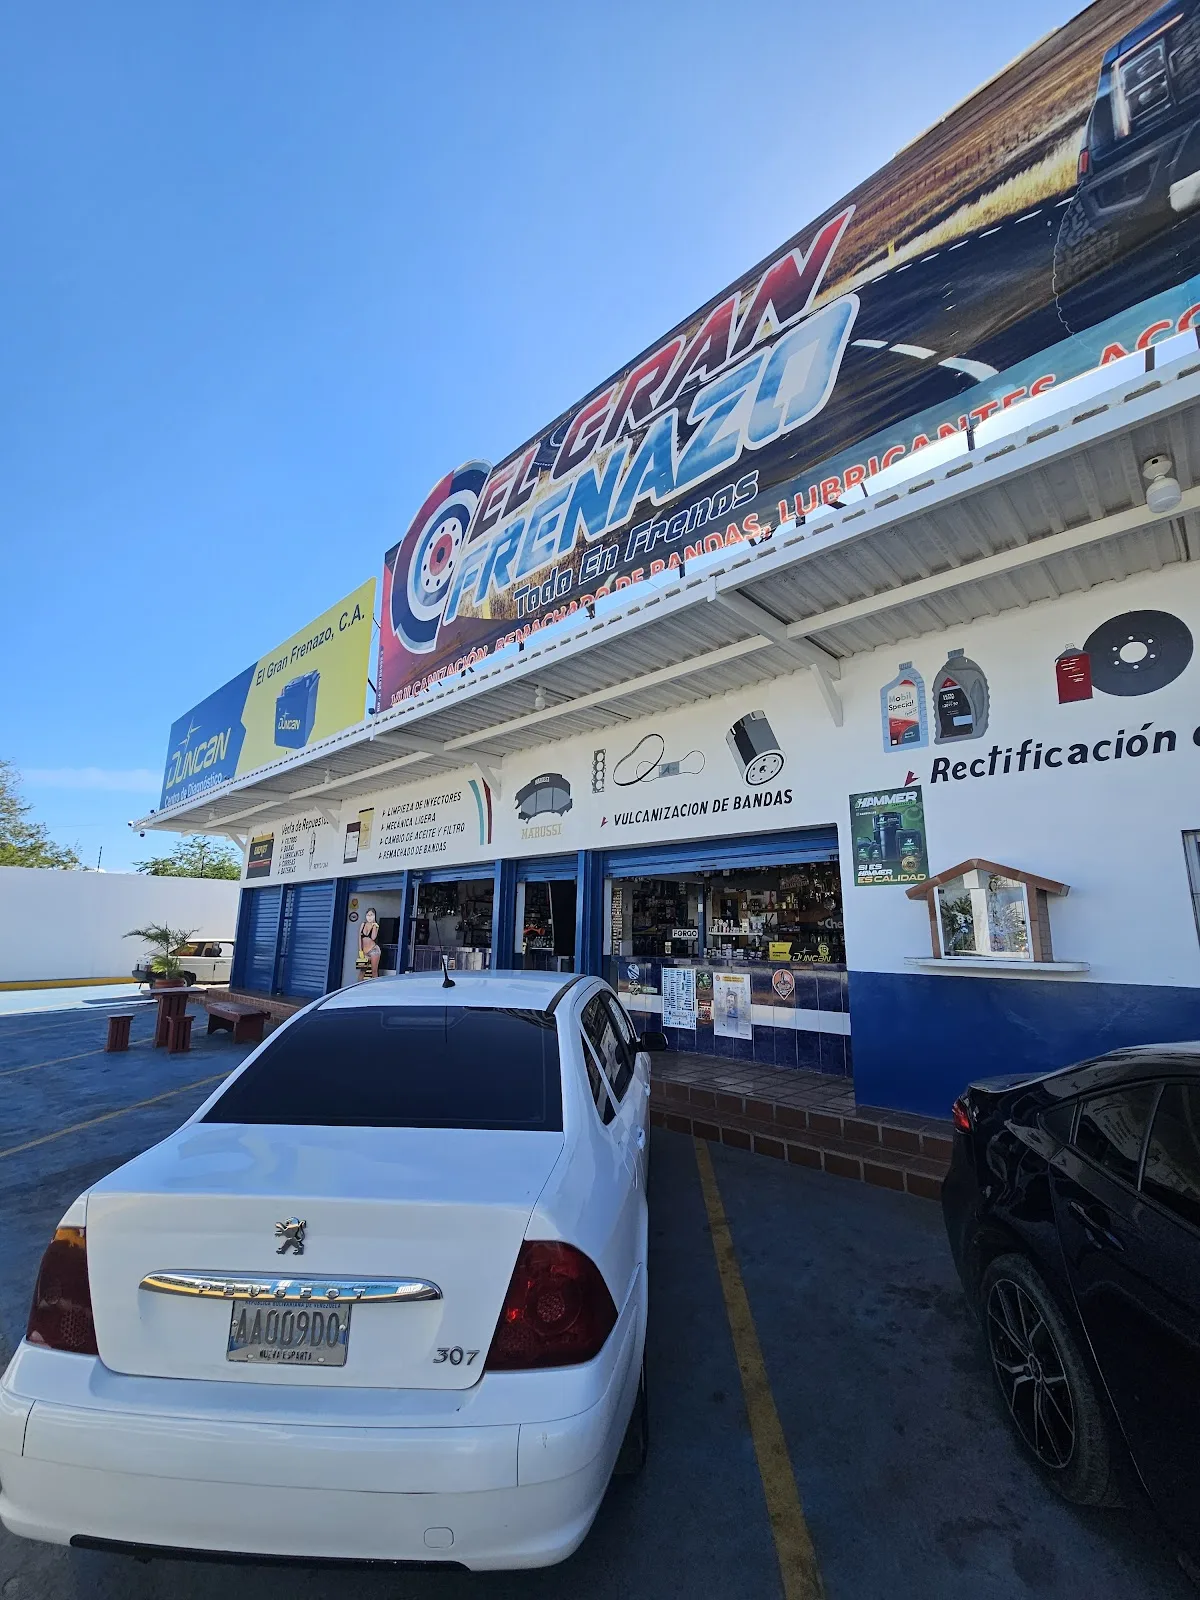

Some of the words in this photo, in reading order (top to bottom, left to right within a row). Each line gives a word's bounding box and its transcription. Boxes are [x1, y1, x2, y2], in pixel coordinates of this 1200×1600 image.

[467, 441, 542, 546] EL
[550, 204, 856, 477] GRAN
[442, 293, 860, 626] FRENAZO
[513, 561, 573, 619] Todo
[579, 544, 619, 585] En
[624, 469, 759, 563] Frenos
[256, 668, 265, 686] El
[266, 656, 288, 679] Gran
[290, 627, 334, 664] Frenazo,
[339, 603, 365, 632] C.A.
[888, 691, 912, 703] Mobil
[888, 700, 914, 711] Special
[930, 721, 1177, 784] Rectificación
[387, 803, 415, 817] LIMPIEZA
[415, 799, 423, 809] DE
[424, 791, 462, 808] INYECTORES
[614, 800, 708, 826] VULCANIZACION
[712, 797, 730, 813] DE
[733, 788, 793, 810] BANDAS
[855, 791, 917, 809] HAMMER
[414, 812, 436, 825] LIGERA
[384, 834, 405, 845] CAMBIO
[405, 833, 413, 841] DE
[414, 828, 436, 840] ACEITE
[437, 826, 442, 837] Y
[443, 822, 465, 835] FILTRO
[521, 823, 562, 840] MARUSSI
[383, 847, 415, 860] REMACHADO
[415, 845, 423, 855] DE
[423, 841, 447, 854] BANDAS
[873, 873, 926, 882] CALIDAD
[195, 1281, 367, 1300] PEUGEOT
[433, 1346, 480, 1366] 307
